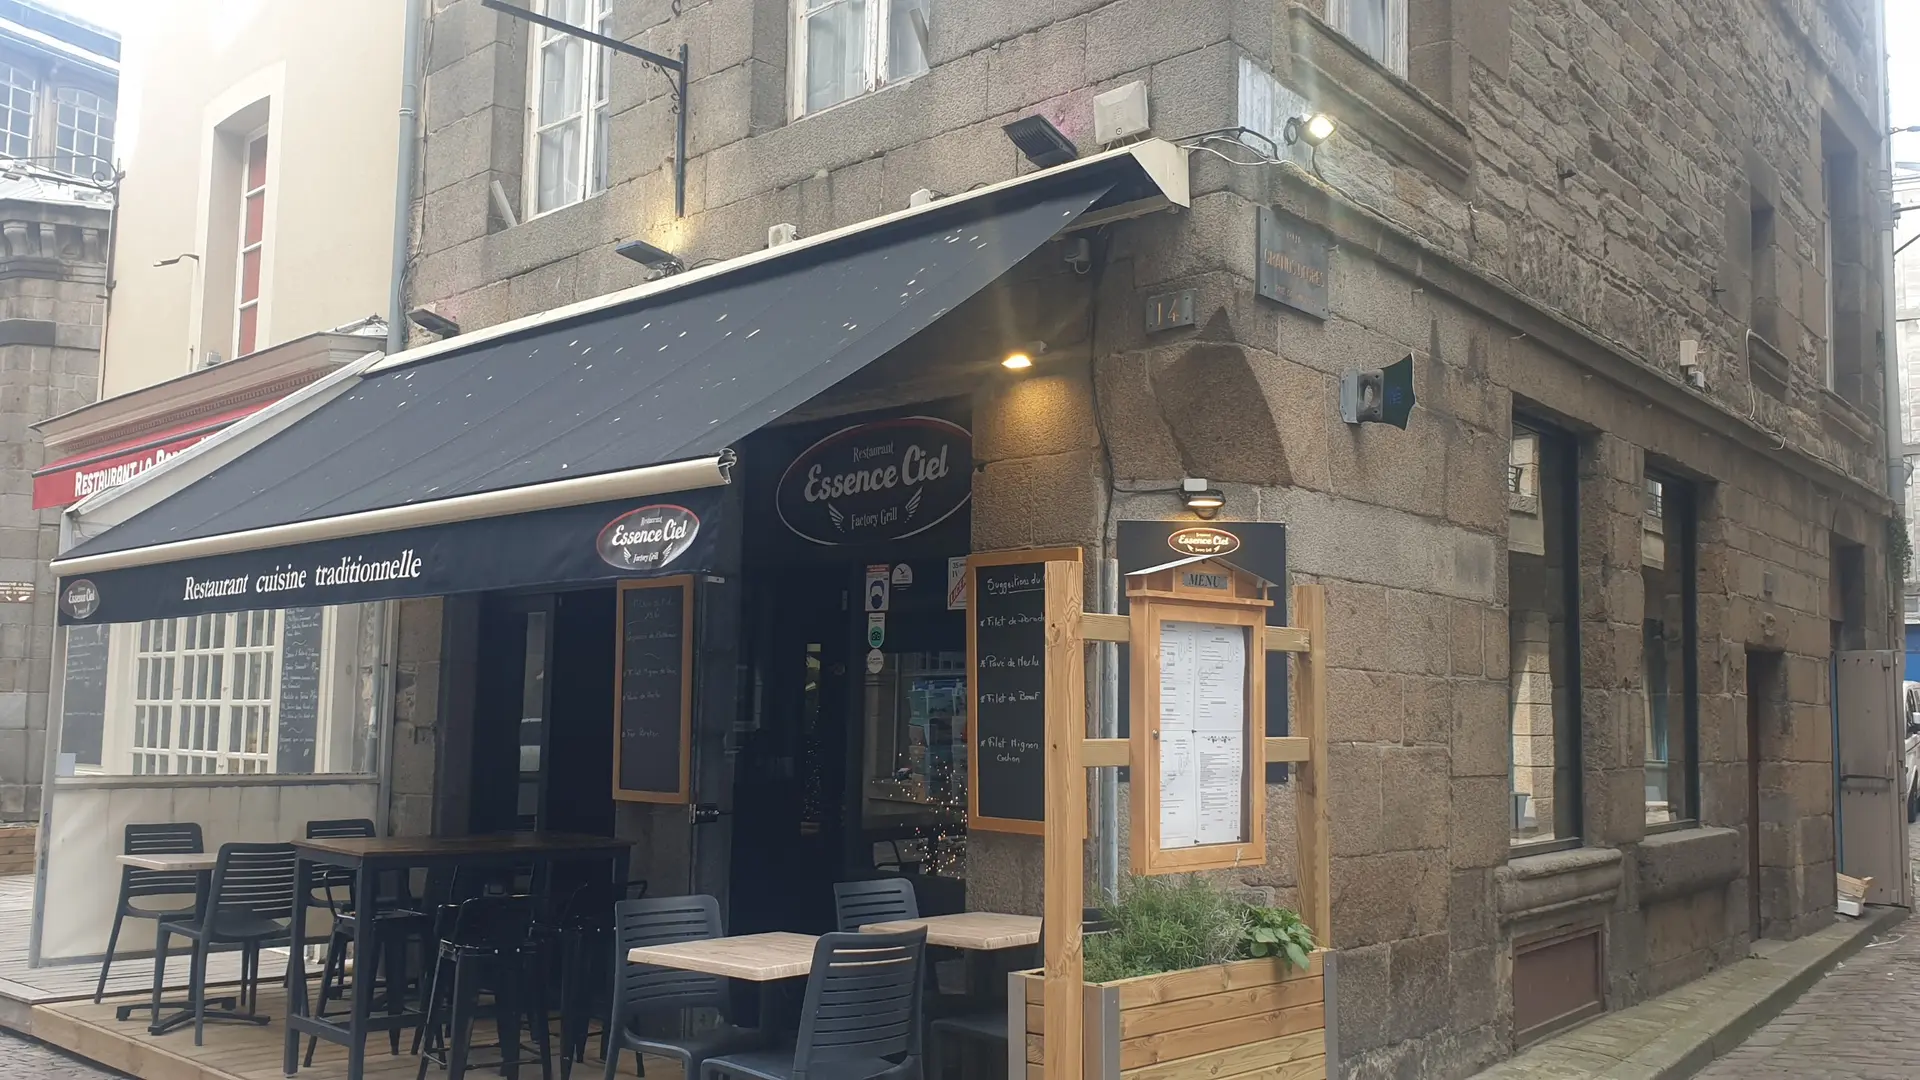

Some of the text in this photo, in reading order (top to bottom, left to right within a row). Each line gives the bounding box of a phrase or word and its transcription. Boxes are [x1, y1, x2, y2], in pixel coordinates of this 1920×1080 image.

[1157, 299, 1179, 326] 14
[853, 441, 894, 463] Restaurant
[74, 461, 138, 497] RESTAURANT
[803, 443, 949, 502] Essence Ciel
[851, 506, 898, 529] Factory Grill
[611, 518, 688, 546] Essence Ciel
[1178, 534, 1212, 545] Essence
[183, 549, 422, 601] Restaurant cuisine traditionnelle
[987, 574, 1029, 594] Suggestions
[1031, 572, 1040, 584] du
[1189, 573, 1221, 588] MENU
[986, 615, 1006, 626] Filet
[1008, 616, 1016, 625] de
[1007, 657, 1016, 667] de
[986, 692, 1006, 703] Filet
[987, 736, 1039, 753] Filet Mignon
